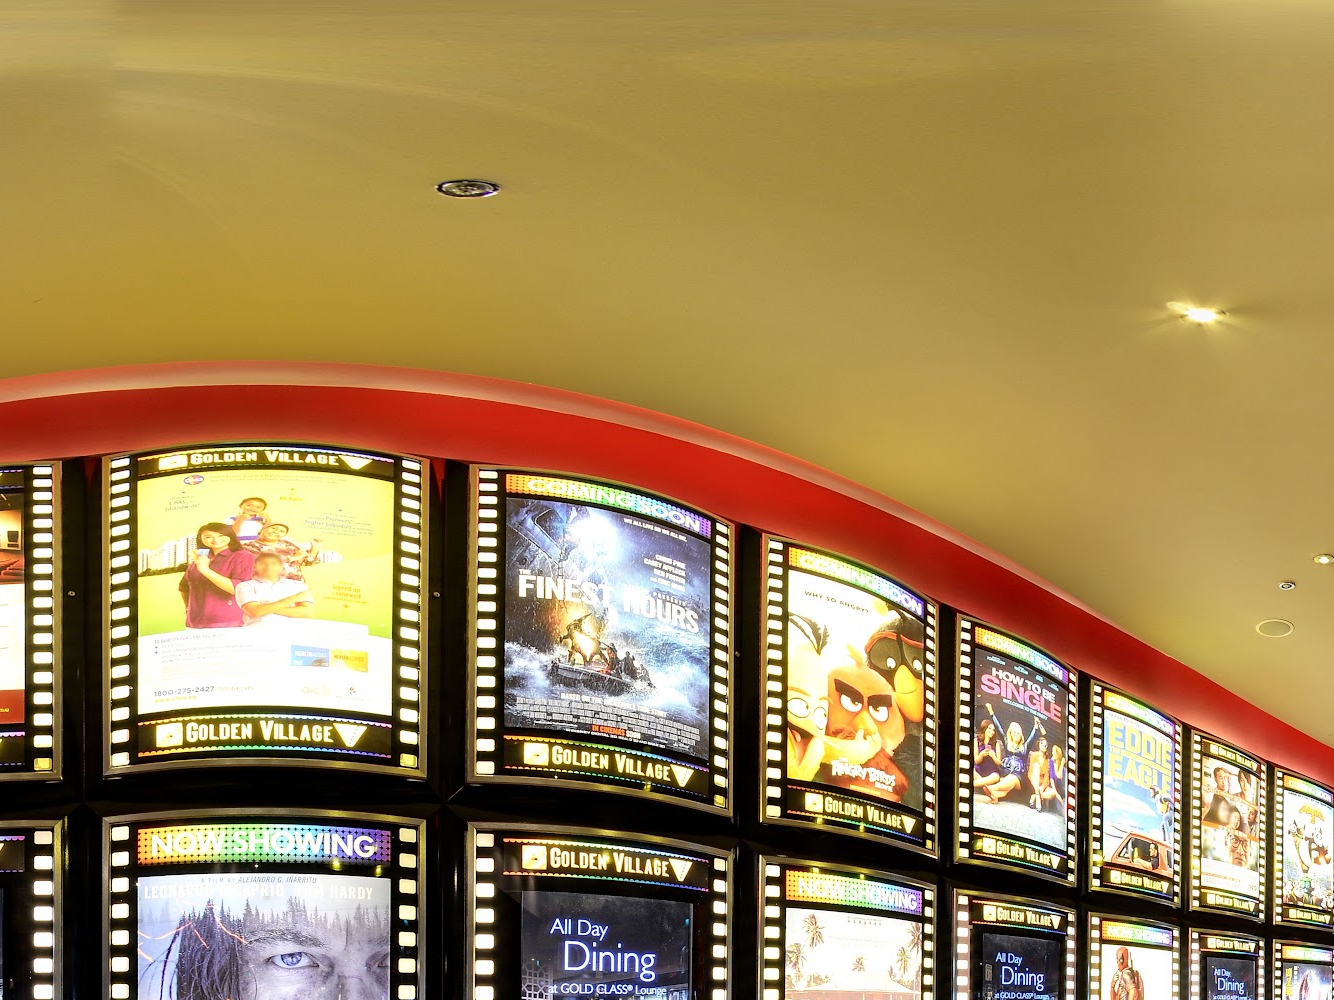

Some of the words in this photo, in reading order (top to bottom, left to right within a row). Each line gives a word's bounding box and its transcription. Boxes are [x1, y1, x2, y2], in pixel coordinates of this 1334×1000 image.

[190, 451, 258, 466] GOLDEN
[265, 450, 339, 466] VILLAGE
[527, 478, 635, 507] COMING
[638, 500, 700, 533] SOON
[519, 574, 615, 609] FINEST
[623, 593, 699, 633] HOURS
[153, 686, 215, 698] 1800-275-2427
[981, 674, 1062, 724] SINGLE
[991, 667, 1025, 687] HOW
[1025, 680, 1041, 695] TO
[1043, 687, 1055, 703] BE
[186, 722, 253, 742] GOLDEN
[259, 720, 334, 743] VILLAGE
[592, 724, 599, 732] IN
[599, 725, 626, 736] CINEMAS
[626, 731, 641, 740] SOON
[1109, 720, 1172, 770] EDDIE
[552, 745, 609, 770] GOLDEN
[615, 754, 671, 782] VILLAGE
[1109, 752, 1171, 795] EAGLE
[151, 830, 226, 856] NOW
[233, 830, 377, 858] SHOWING
[549, 848, 607, 870] GOLDEN
[613, 852, 671, 878] VILLAGE
[798, 878, 845, 899] NOW
[849, 884, 918, 910] SHOWING
[550, 918, 572, 935] All
[577, 920, 609, 941] Day
[564, 940, 656, 981] Dining
[995, 952, 1007, 963] All
[1007, 952, 1023, 966] Day
[548, 985, 558, 994] at
[561, 983, 594, 994] GOLD
[635, 984, 667, 998] Lounge
[1001, 966, 1045, 991] Dining
[1217, 978, 1245, 994] Dining
